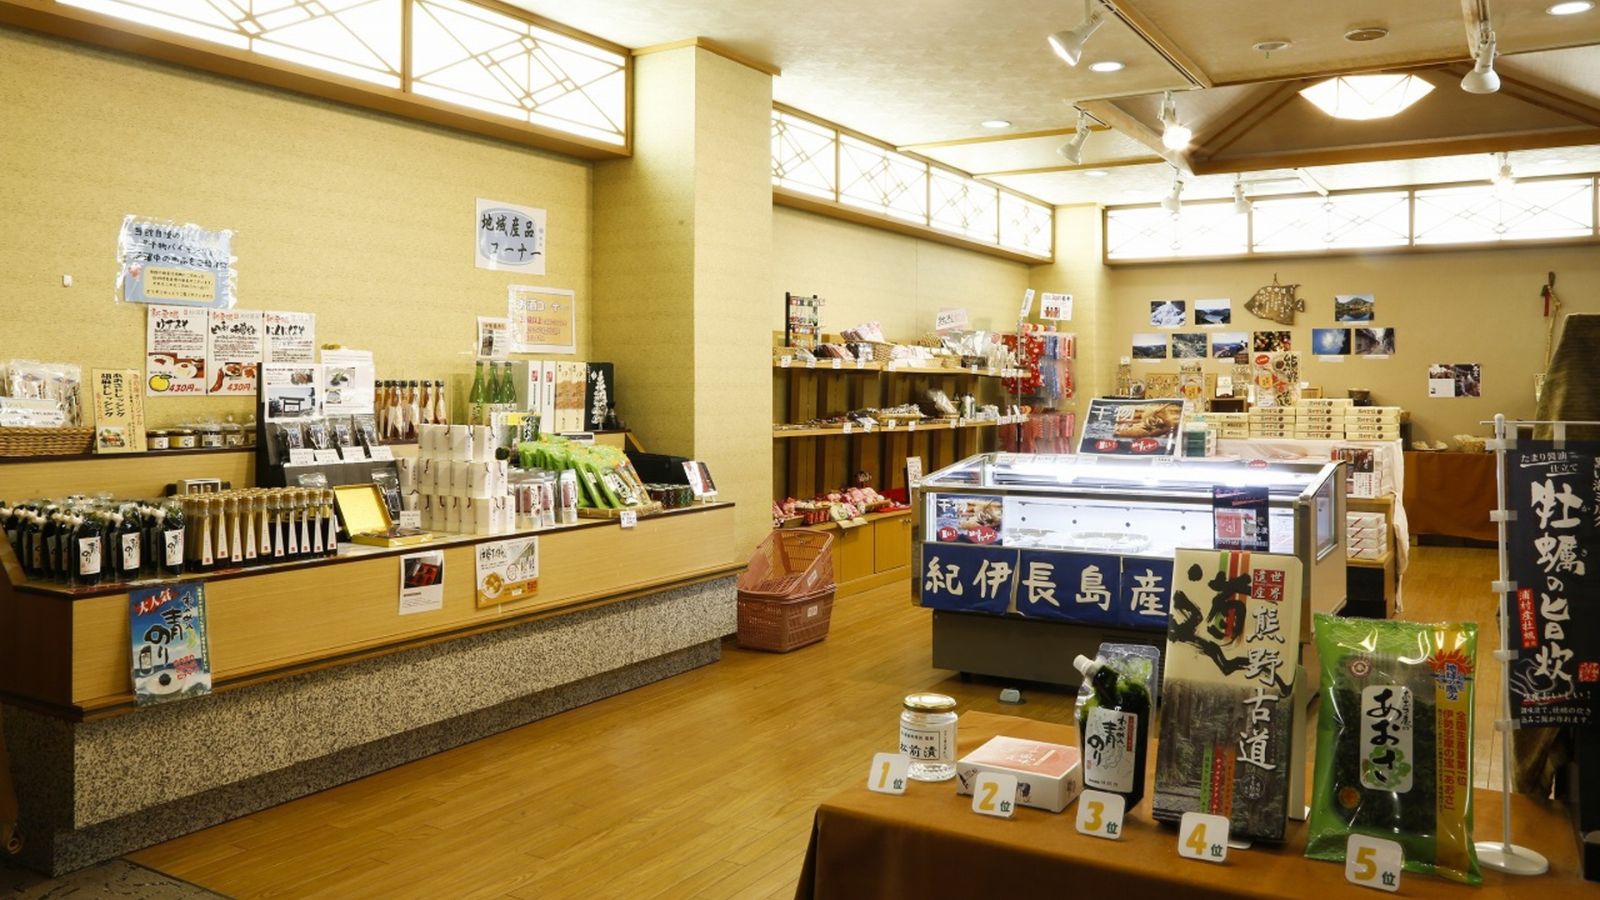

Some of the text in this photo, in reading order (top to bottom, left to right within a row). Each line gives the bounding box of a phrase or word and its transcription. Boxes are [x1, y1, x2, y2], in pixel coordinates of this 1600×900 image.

[480, 213, 535, 238] 地域産品
[1520, 451, 1568, 464] たまり醤油
[1550, 463, 1579, 473] 仕立て
[925, 556, 1168, 617] 紀伊長島産
[1254, 570, 1267, 599] 遺産
[1270, 570, 1282, 601] 世界
[137, 587, 173, 617] 大人気
[144, 606, 184, 665] 青のり
[1236, 605, 1286, 771] 熊野古道
[1087, 720, 1119, 767] 青のり
[1366, 687, 1402, 784] あおさ
[877, 761, 904, 790] 1位
[978, 781, 1012, 813] 2位
[1083, 800, 1119, 835] 3位
[1185, 822, 1224, 858] 4位
[1353, 845, 1397, 887] 5位
